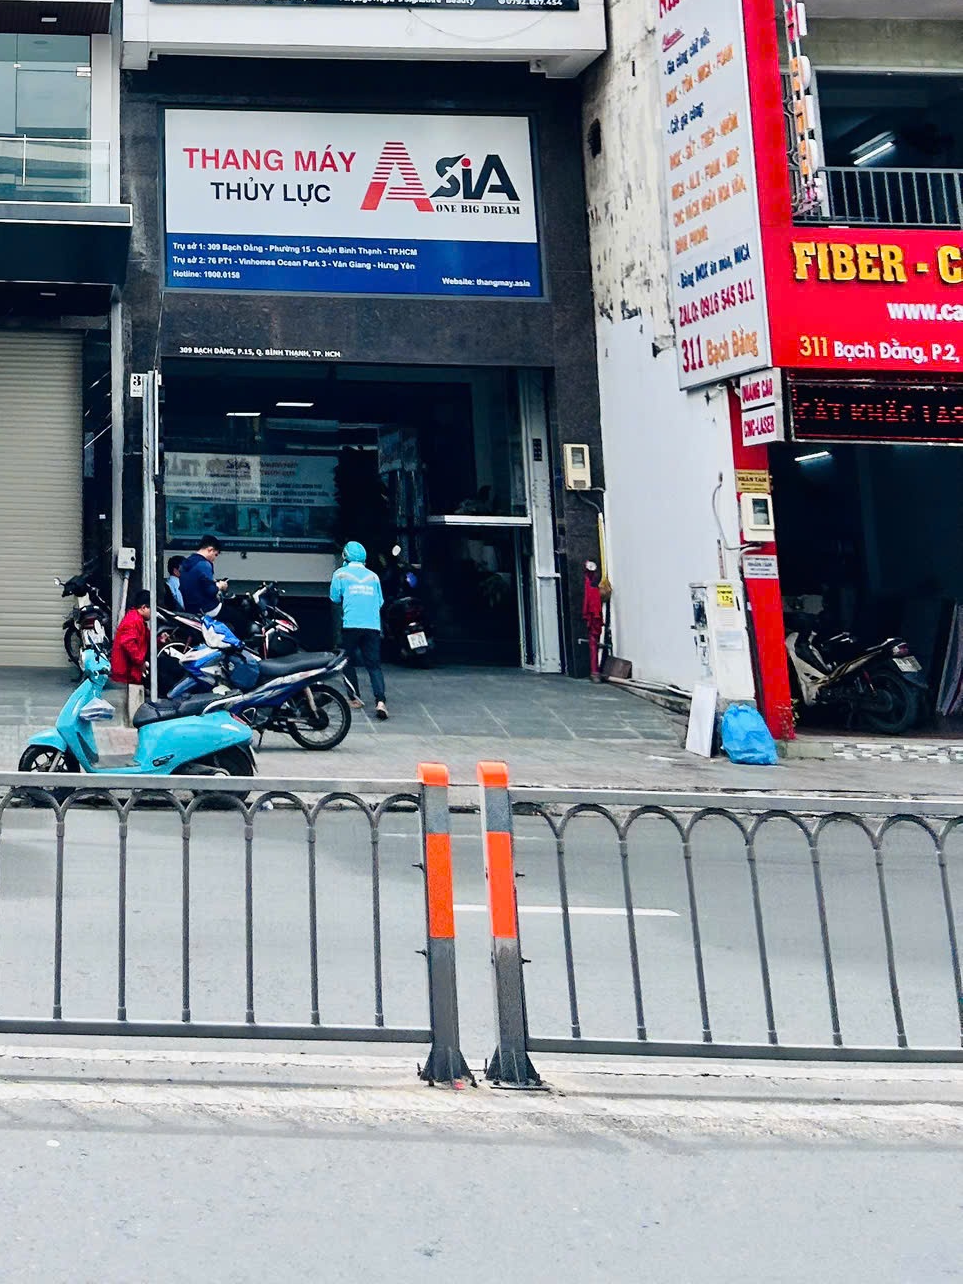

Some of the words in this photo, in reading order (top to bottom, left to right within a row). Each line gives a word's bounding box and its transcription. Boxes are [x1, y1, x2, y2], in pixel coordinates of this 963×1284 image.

[183, 147, 284, 172] THANG
[294, 144, 357, 173] MÁY
[210, 177, 275, 201] THỦY
[283, 183, 331, 207] LỰC
[436, 204, 458, 213] ONE
[461, 204, 479, 214] BIG
[483, 205, 520, 214] DREAM
[207, 243, 220, 251] 309
[222, 243, 242, 253] Bạch
[269, 244, 300, 254] Phường
[301, 245, 311, 253] 15
[317, 245, 337, 255] Quận
[357, 246, 382, 256] Thạnh
[388, 248, 418, 256] TP.HCM
[218, 257, 233, 265] PT1
[238, 257, 276, 266] Vinhomes
[277, 258, 302, 267] Ocean
[303, 259, 320, 267] Park
[349, 260, 371, 270] Giang
[377, 261, 399, 271] Hưng
[792, 241, 908, 284] FIBER
[173, 270, 202, 278] Hotline:
[442, 277, 475, 286] Website:
[476, 278, 531, 288] thangmay.asia
[700, 291, 720, 320] 0916
[720, 284, 736, 311] 545
[737, 278, 755, 305] 911
[179, 346, 192, 354] 309
[193, 346, 213, 356] BẠCH
[256, 348, 264, 357] Q.
[265, 347, 283, 357] BÌNH
[285, 349, 311, 358] THẠNH,
[312, 350, 324, 358] TP.
[325, 350, 341, 358] HCM
[681, 334, 704, 374] 311
[706, 333, 730, 370] Bạch
[732, 323, 759, 358] Đằng
[800, 335, 828, 357] 311
[833, 340, 875, 362] Bạch
[880, 337, 928, 364] Đằng,
